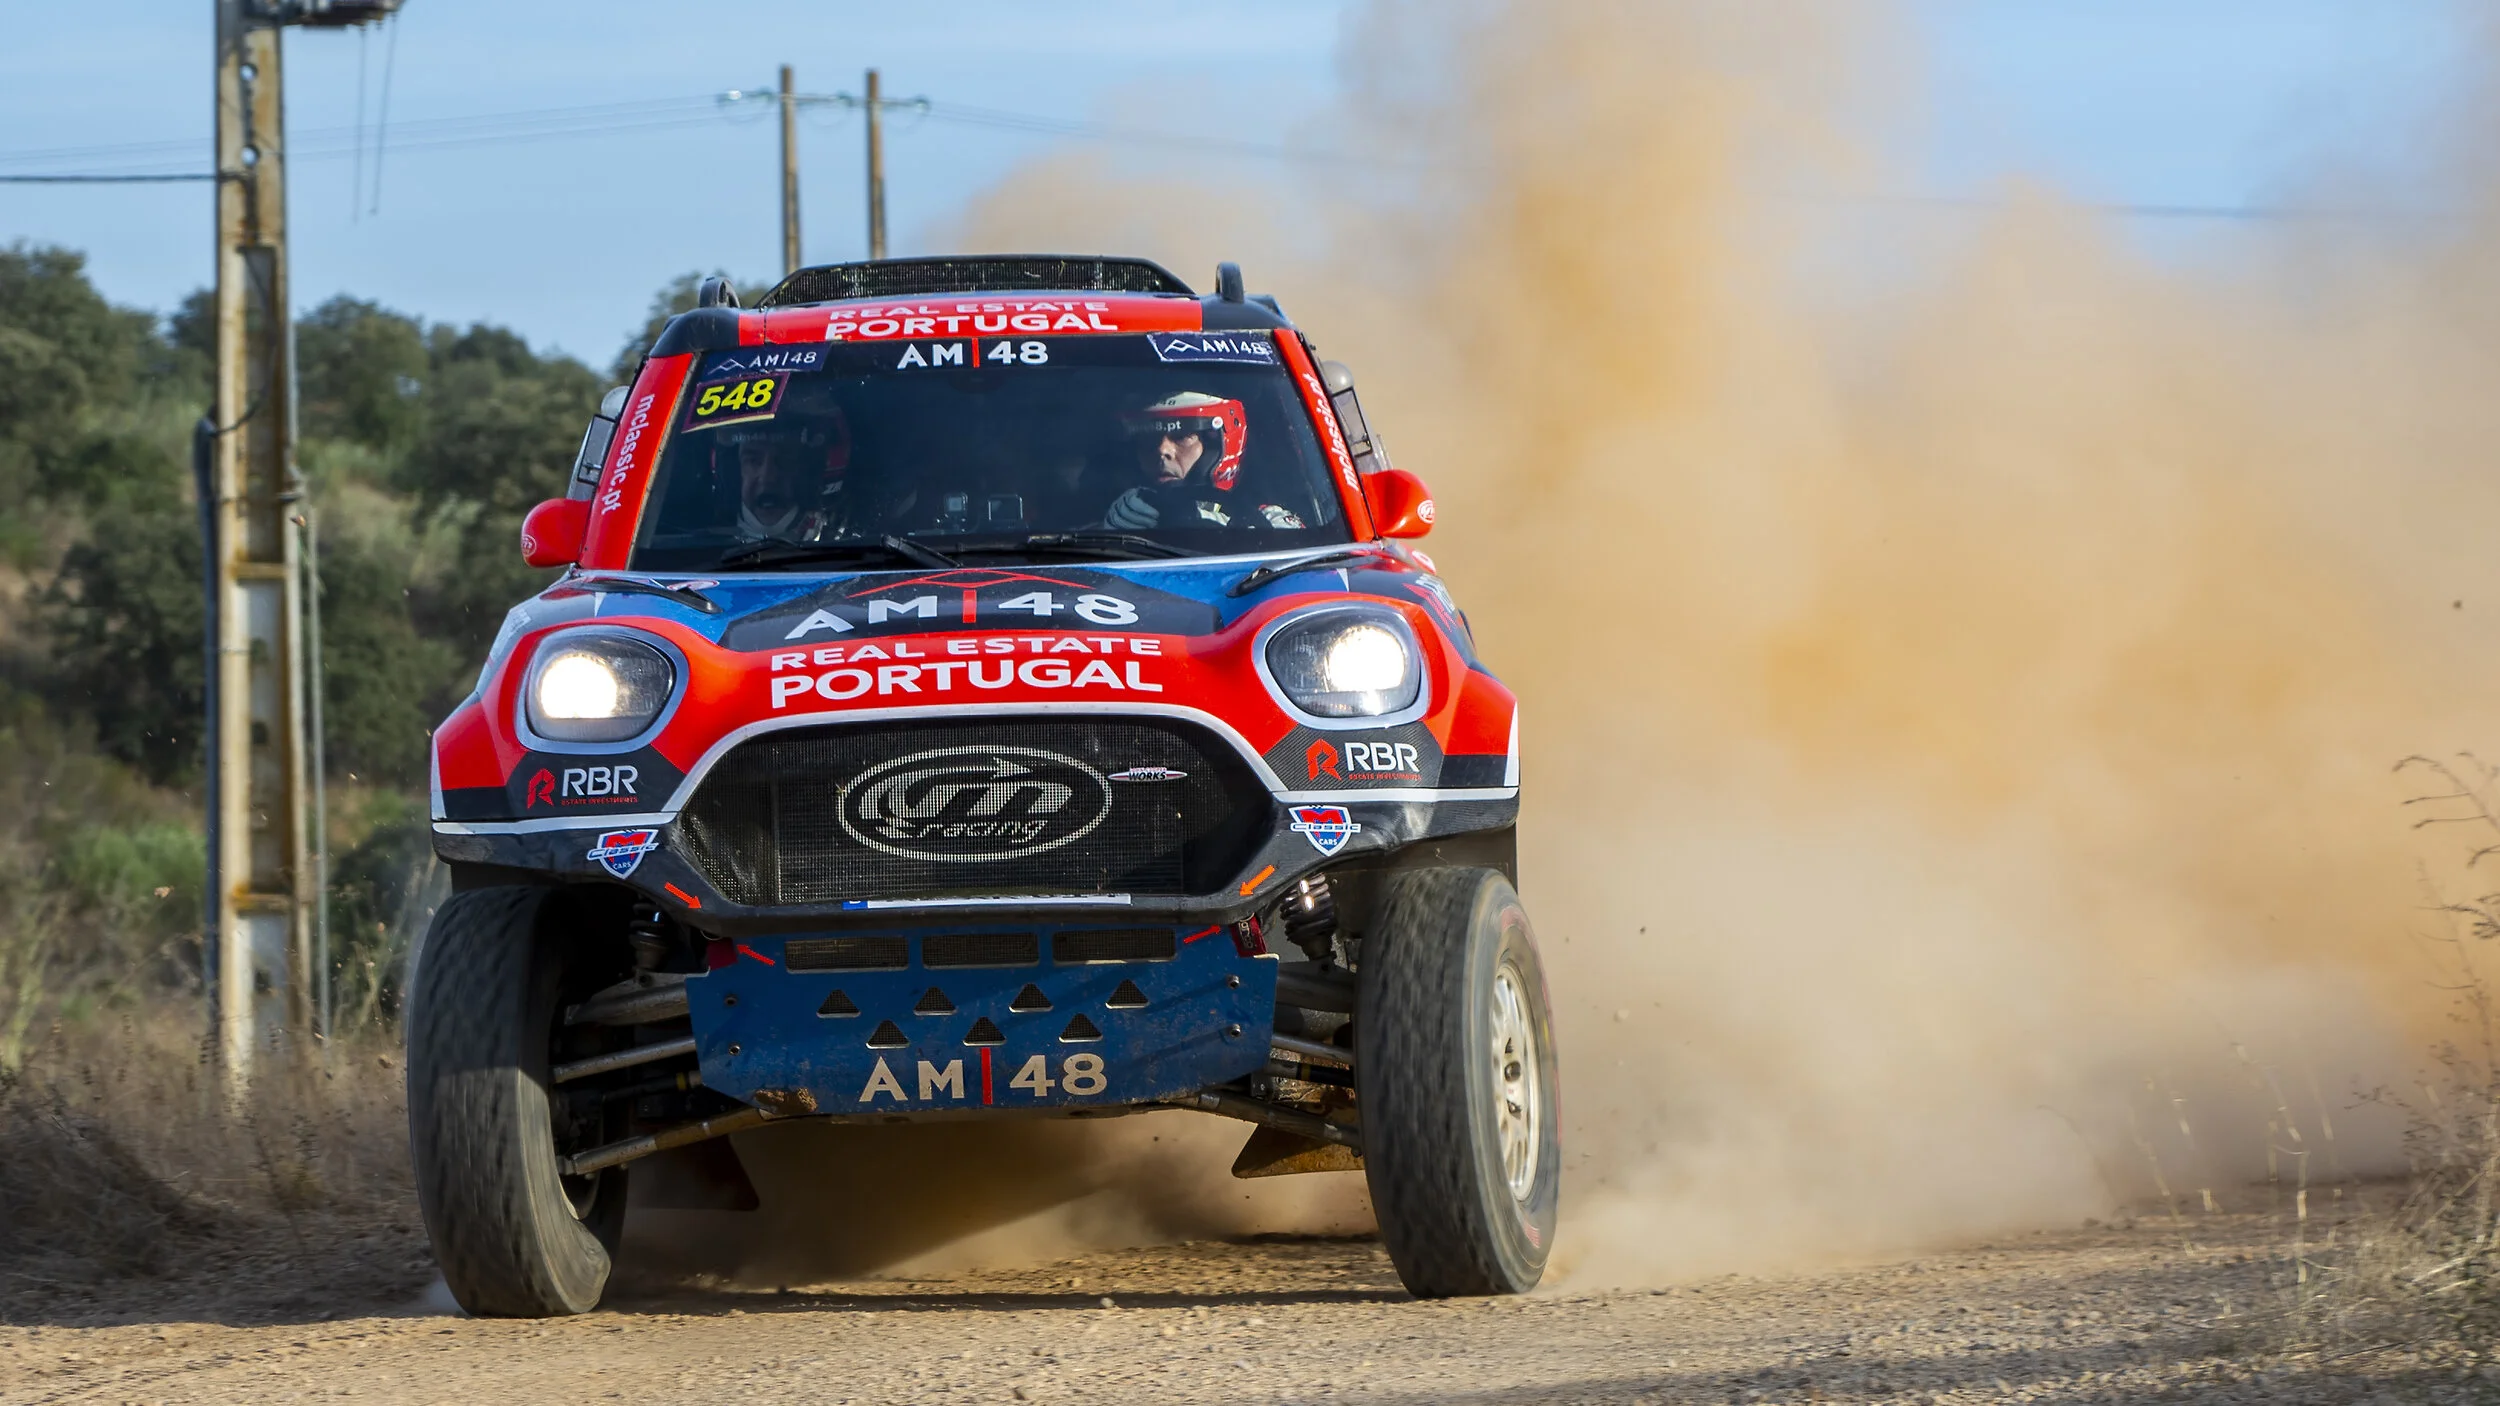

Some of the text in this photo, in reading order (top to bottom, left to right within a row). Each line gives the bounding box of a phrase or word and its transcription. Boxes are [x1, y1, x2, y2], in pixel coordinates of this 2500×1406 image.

[829, 301, 1110, 320] REAL ESTATE
[824, 313, 1119, 341] PORTUGAL
[696, 378, 775, 416] 548
[601, 393, 655, 516] mclassic.pt
[771, 636, 1162, 672] REAL ESTATE
[771, 658, 1164, 710] PORTUGAL
[1345, 742, 1421, 772] RBR
[561, 765, 639, 797] RBR
[1128, 771, 1167, 781] WORKS
[1293, 823, 1360, 831] Classic
[588, 843, 656, 858] Classic
[1318, 838, 1338, 846] CARS
[613, 861, 633, 870] CARS
